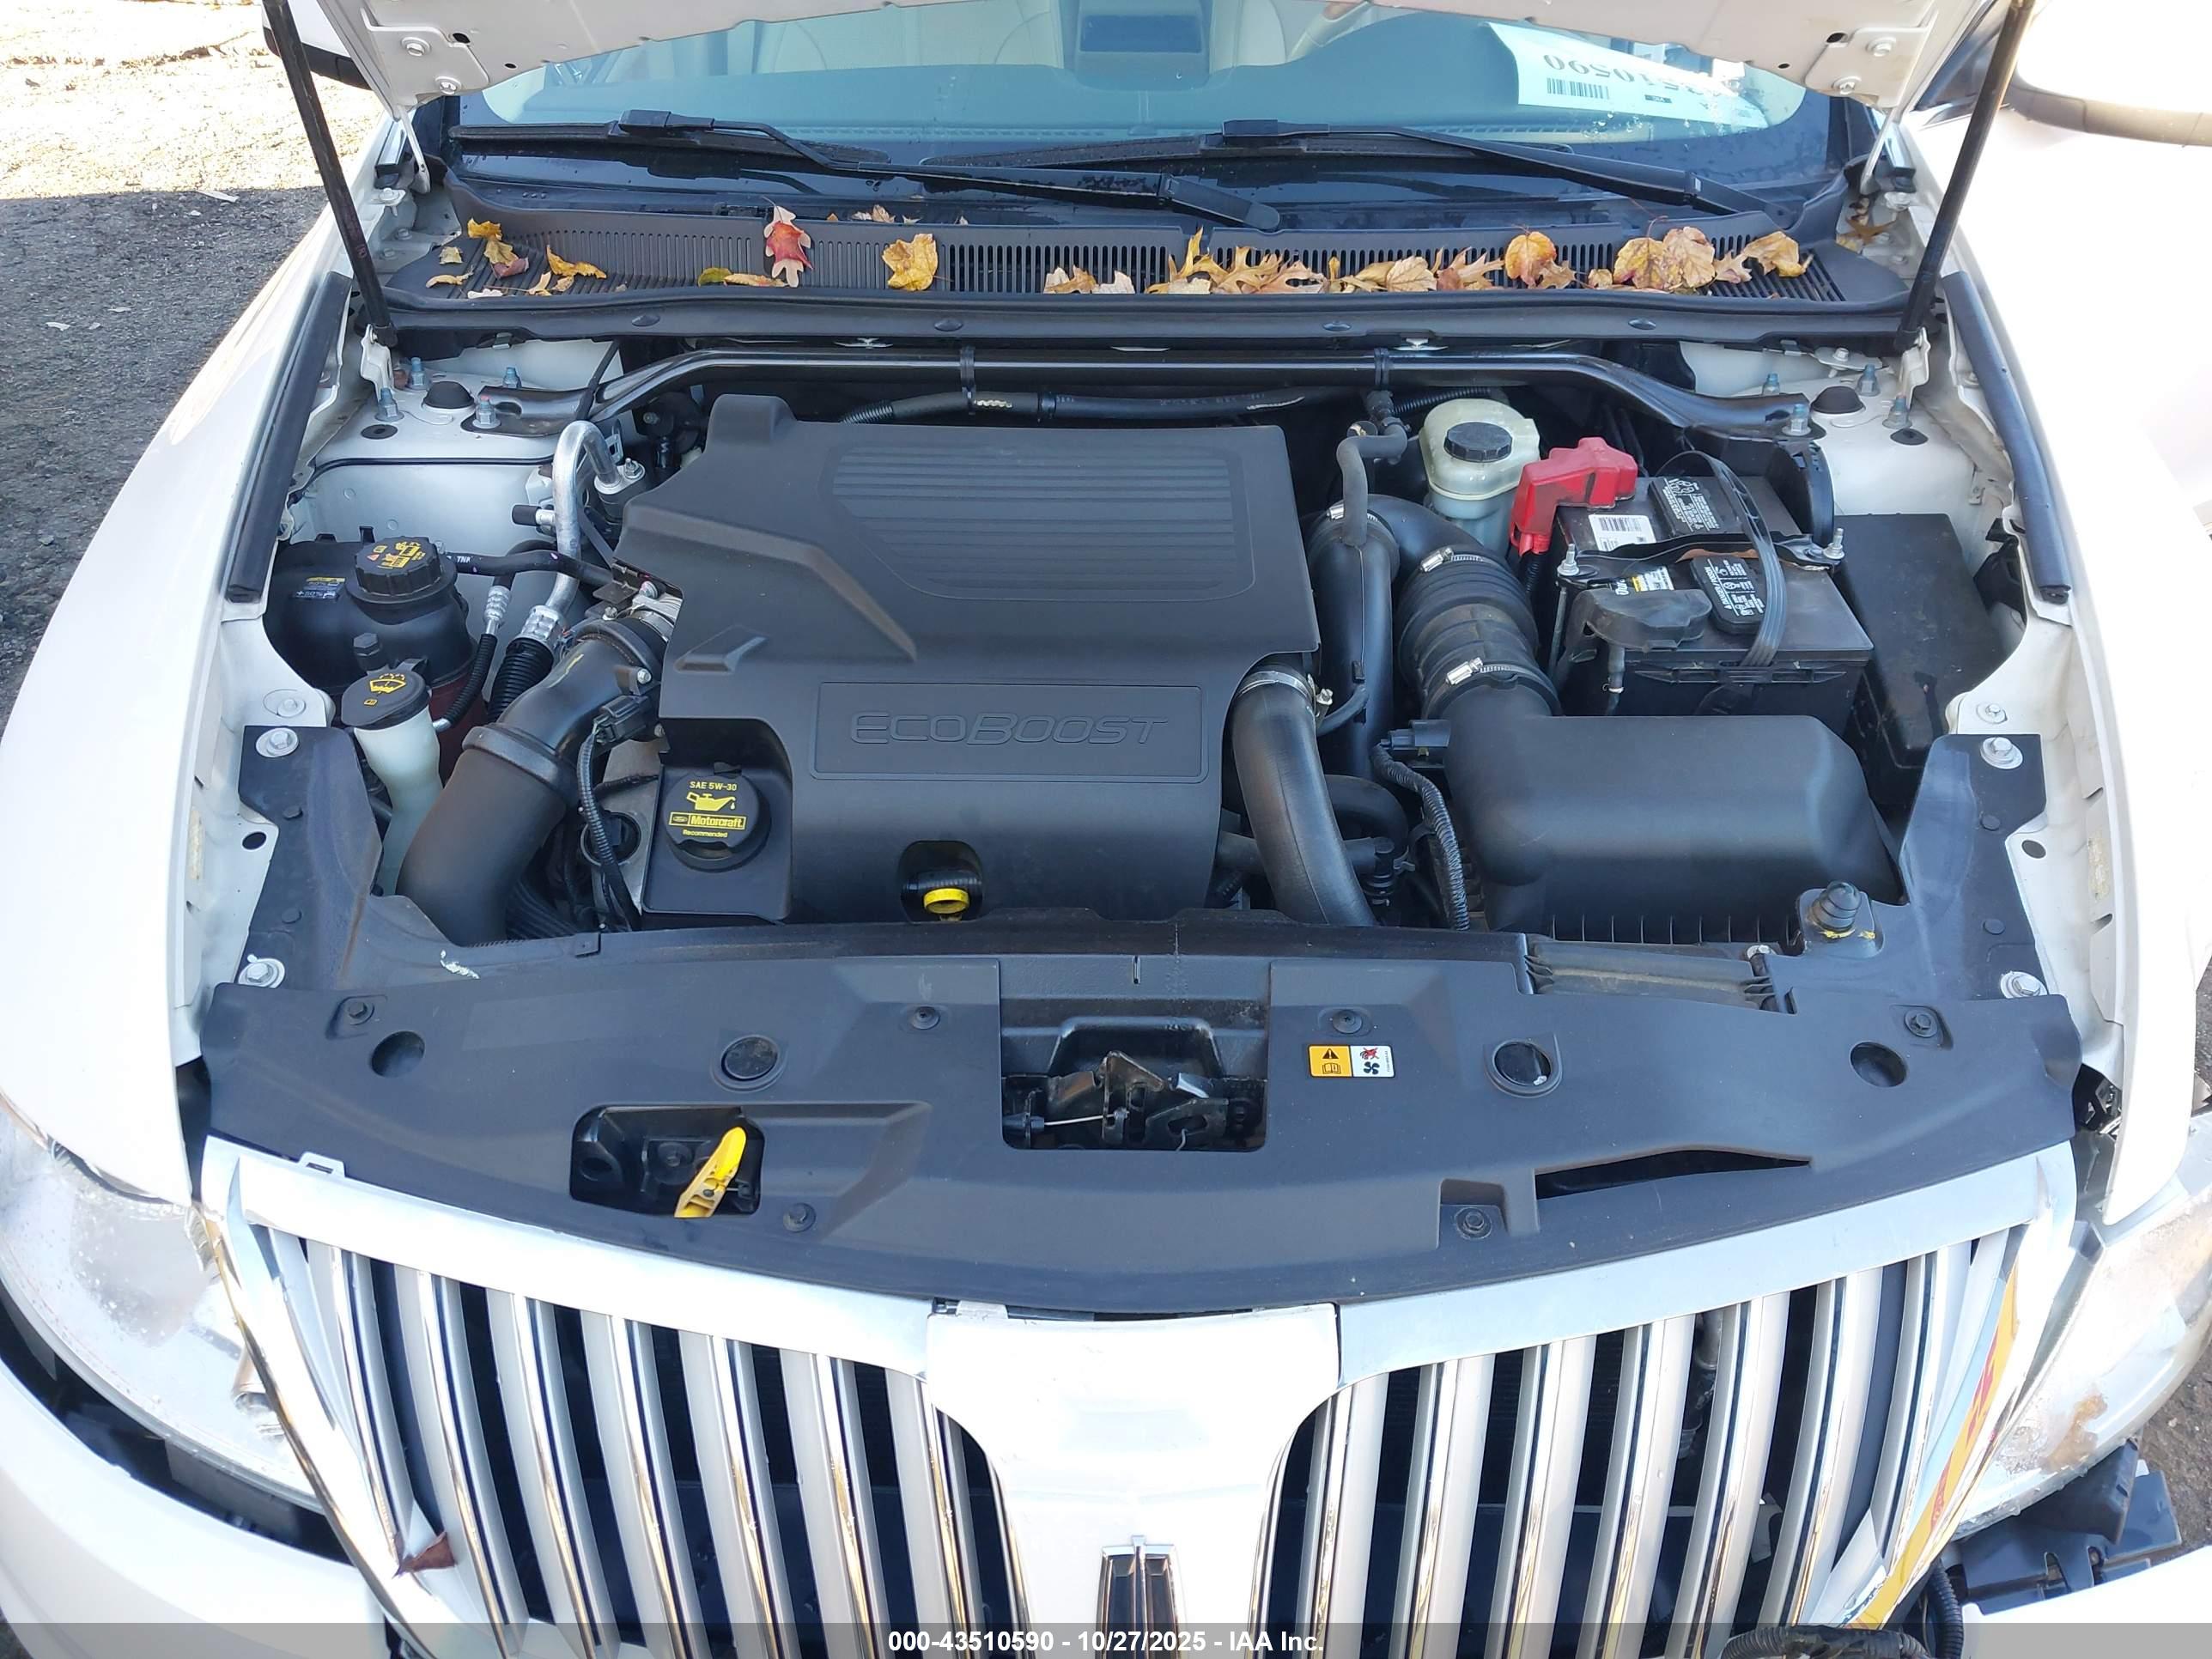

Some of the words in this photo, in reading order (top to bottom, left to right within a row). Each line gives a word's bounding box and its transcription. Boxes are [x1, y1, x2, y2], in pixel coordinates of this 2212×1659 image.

[690, 781, 707, 790] SAE
[708, 782, 737, 792] 5W-30
[690, 815, 741, 828] Motorcraft
[682, 829, 728, 838] Recommended
